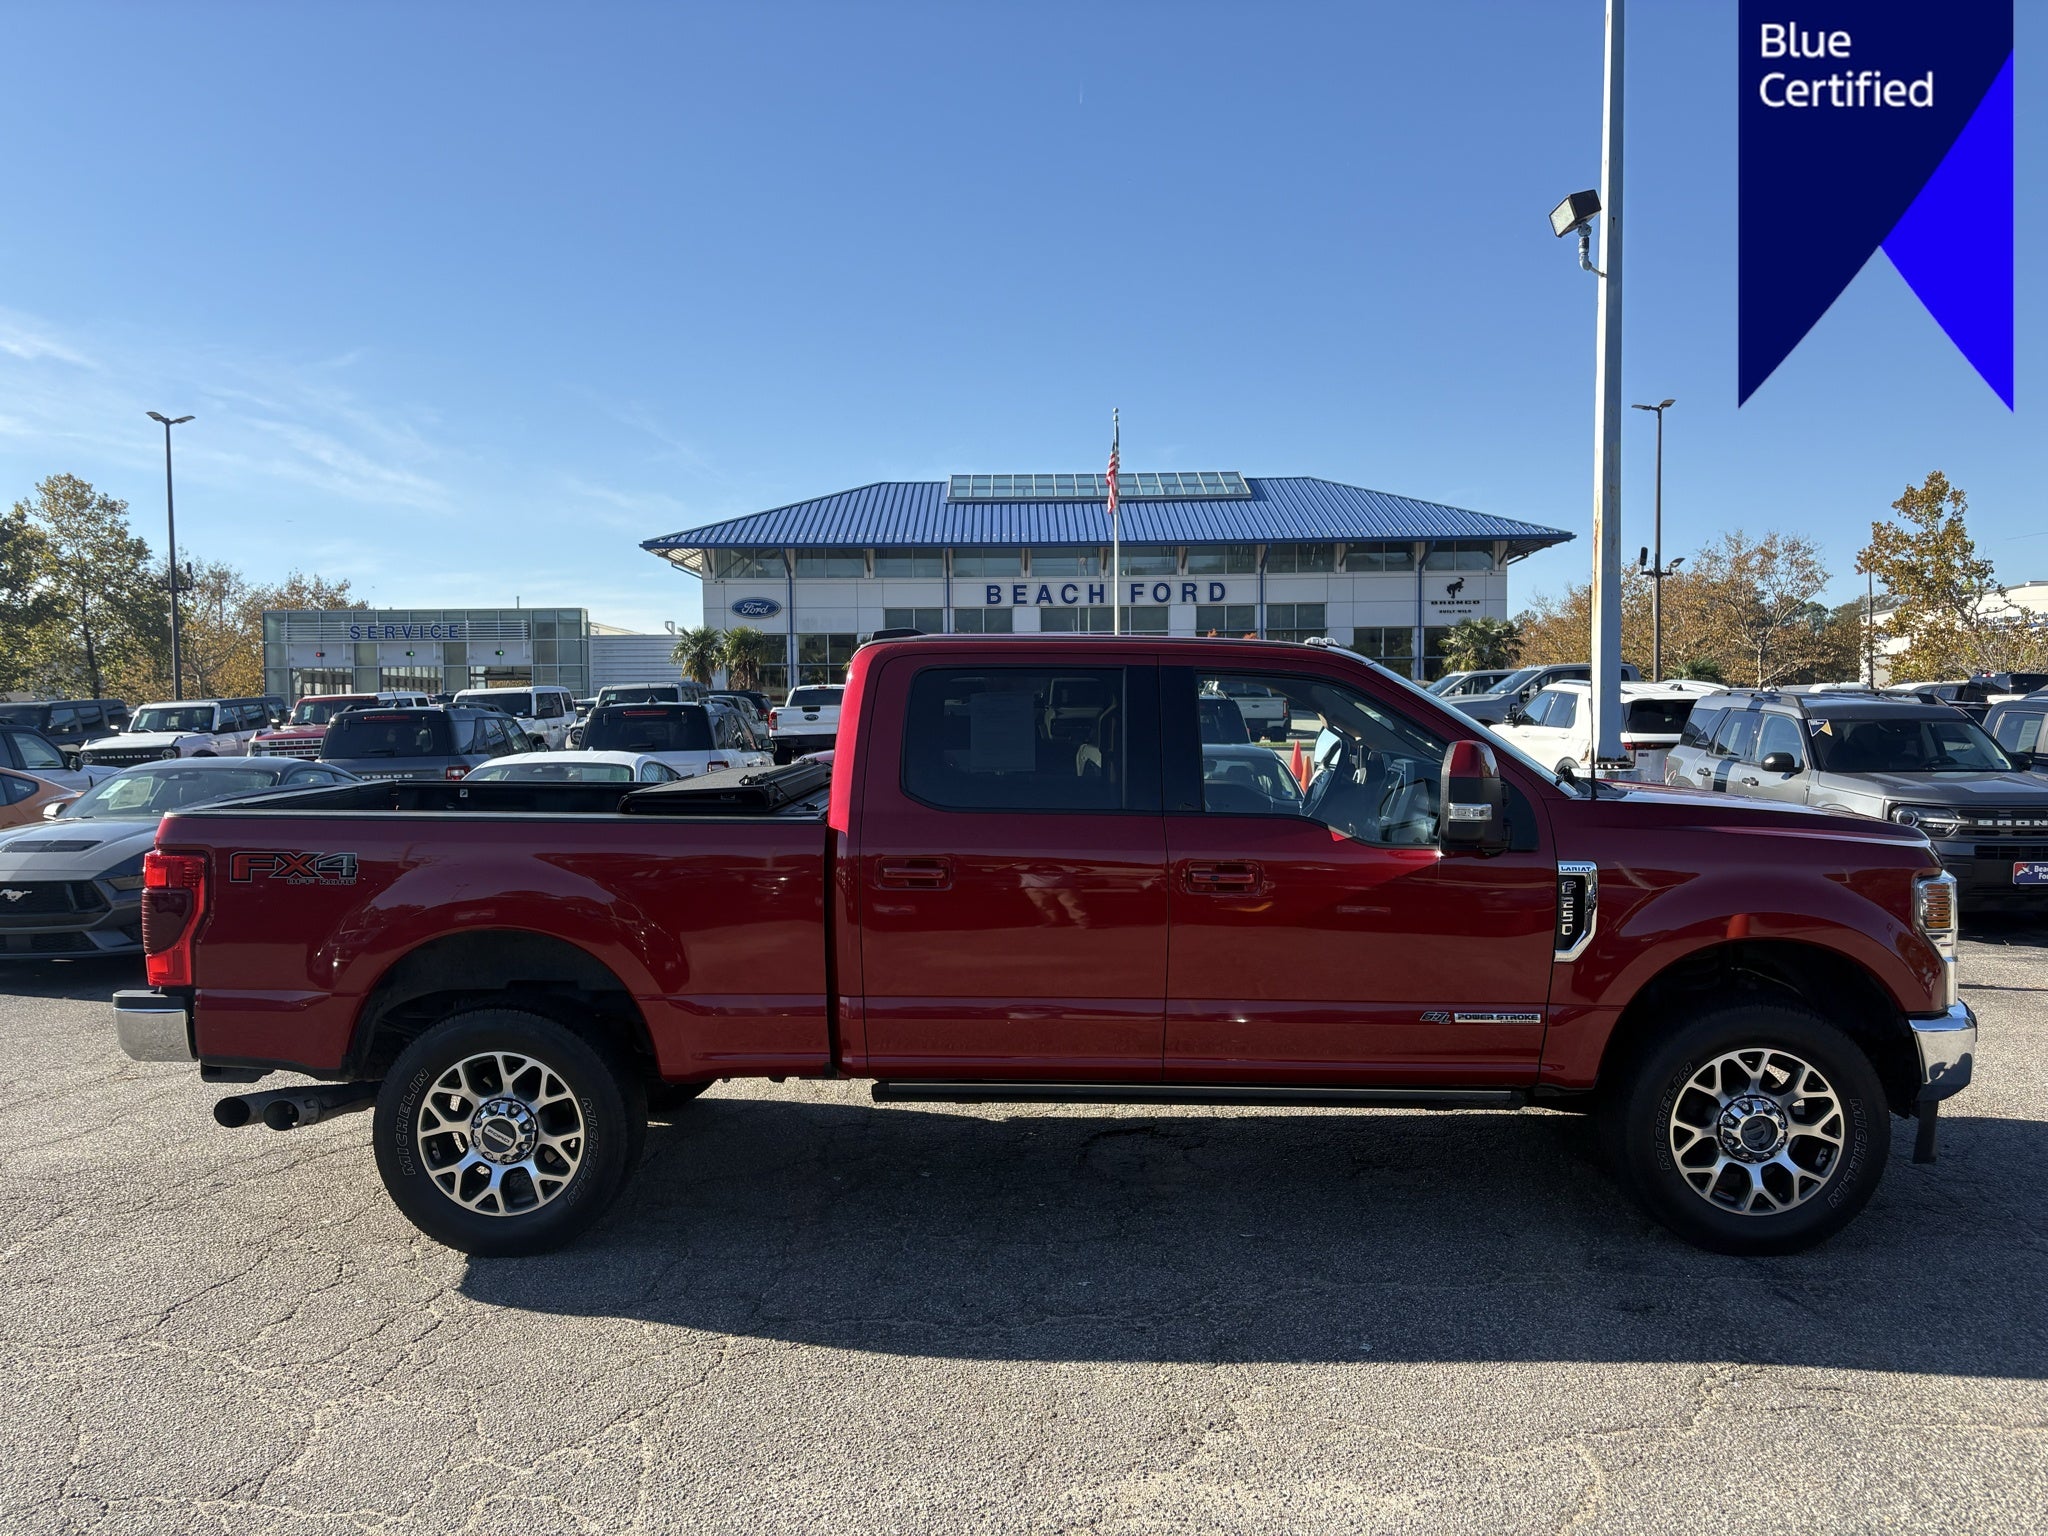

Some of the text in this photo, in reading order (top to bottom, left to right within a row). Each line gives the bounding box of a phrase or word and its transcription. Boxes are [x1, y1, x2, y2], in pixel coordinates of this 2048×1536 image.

[986, 582, 1226, 605] BEACH FORD
[349, 625, 459, 640] SERVICE
[229, 851, 359, 882] FX4
[1457, 1013, 1494, 1021] POWER
[1496, 1013, 1539, 1021] STROKE
[396, 1068, 430, 1176] MICHELIN
[1655, 1062, 1693, 1171] MICHELIN
[567, 1097, 600, 1207] MICHELIN
[1828, 1098, 1868, 1208] MICHELIN
